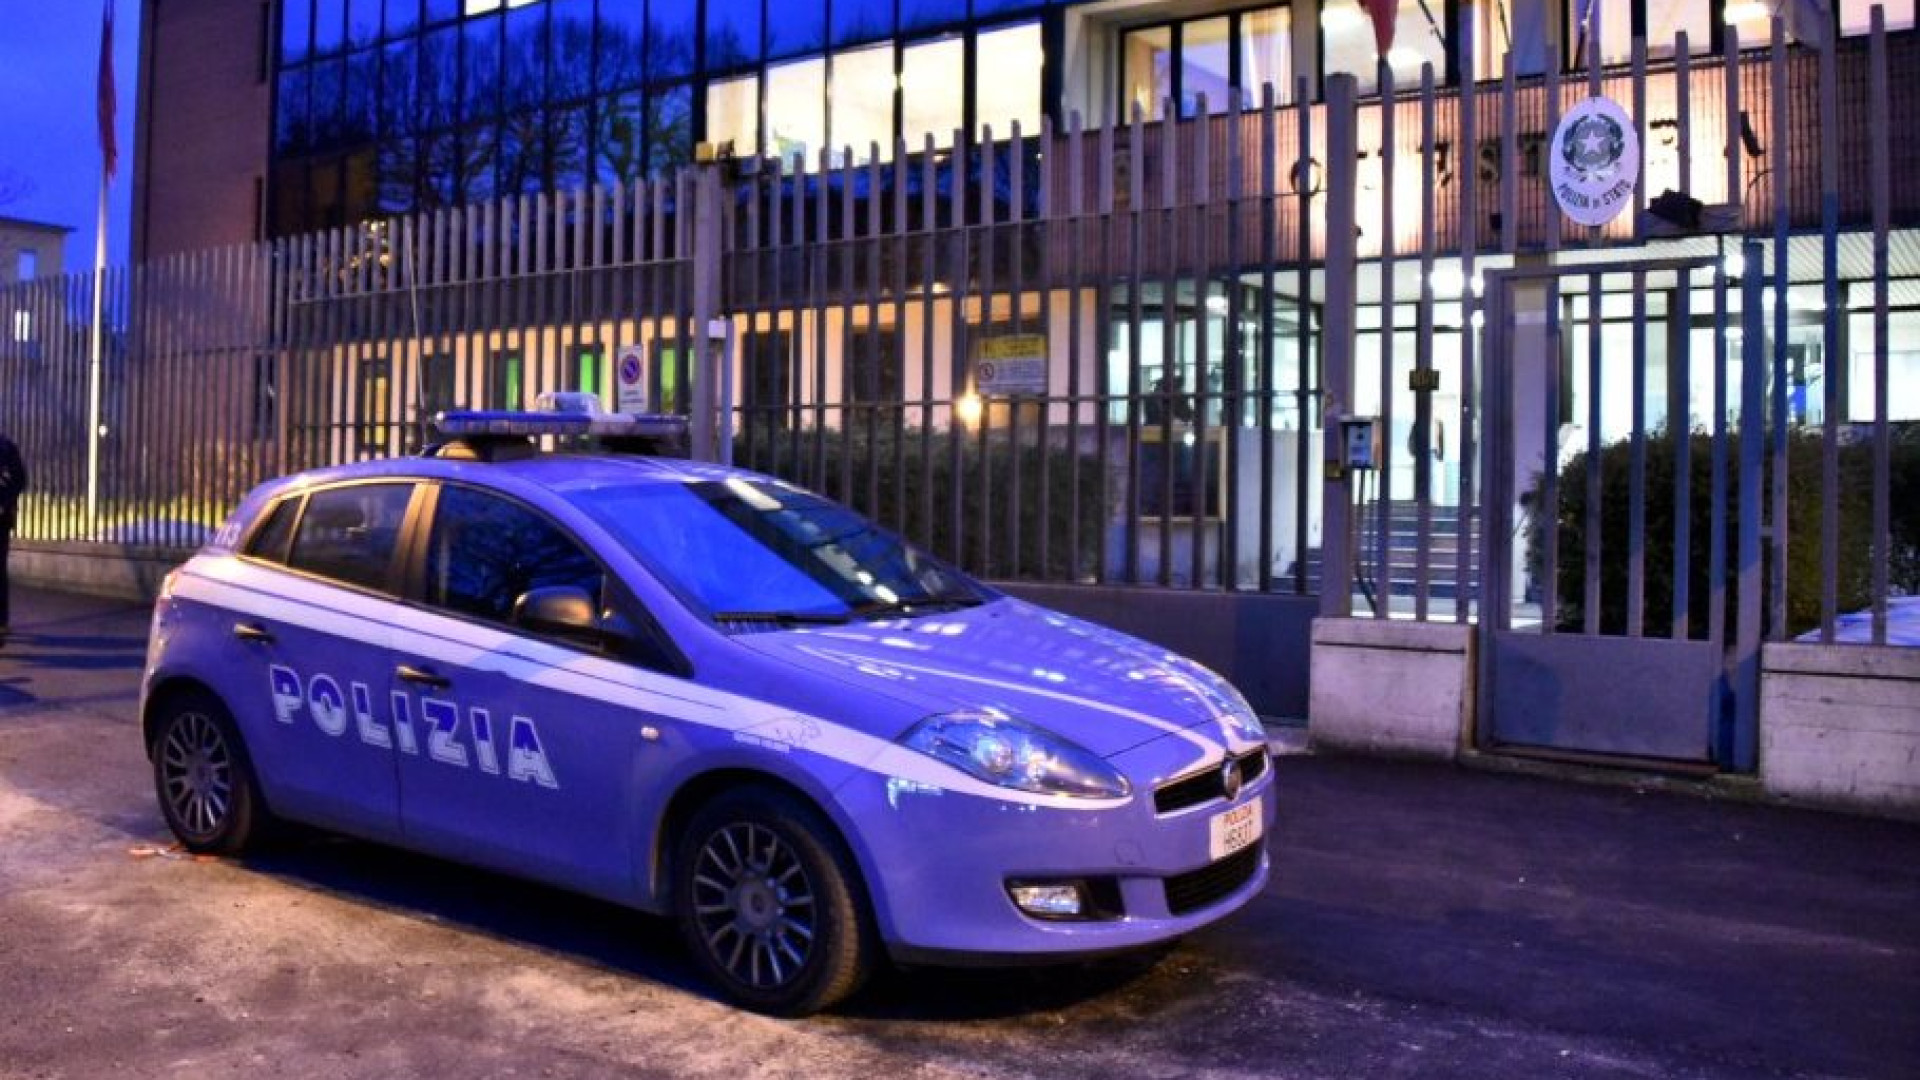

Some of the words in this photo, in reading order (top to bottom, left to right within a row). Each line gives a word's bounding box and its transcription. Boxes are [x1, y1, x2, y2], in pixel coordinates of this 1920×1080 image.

[1557, 183, 1589, 208] POLIZIA
[1602, 179, 1631, 205] STATO
[269, 663, 559, 790] POLIZIA
